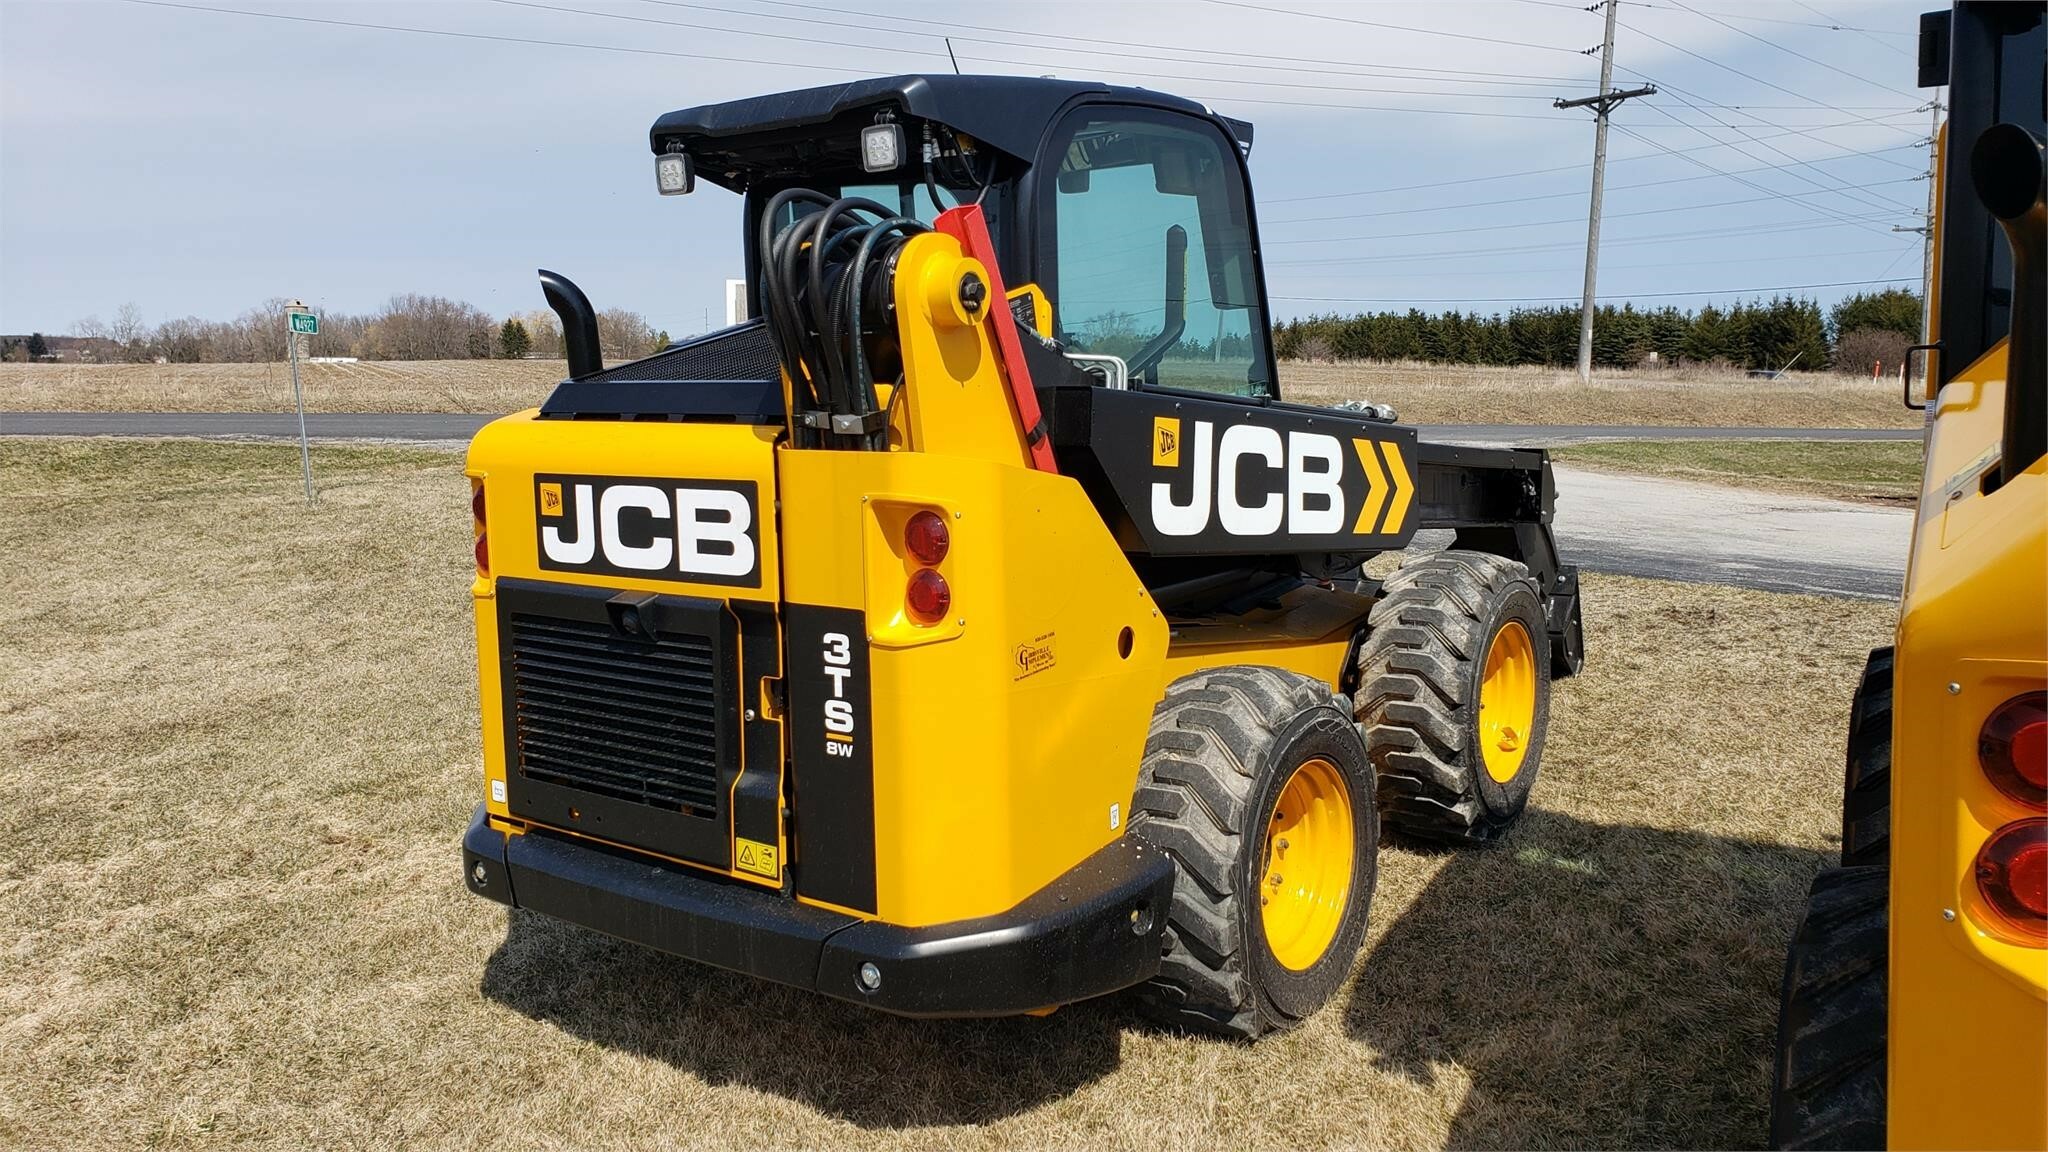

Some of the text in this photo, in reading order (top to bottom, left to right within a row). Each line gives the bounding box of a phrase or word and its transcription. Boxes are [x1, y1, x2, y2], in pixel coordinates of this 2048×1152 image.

[1160, 430, 1176, 451] JCB
[1151, 421, 1345, 536] JCB
[546, 491, 560, 507] JCB
[542, 483, 755, 577] JCB
[826, 741, 854, 758] 8W
